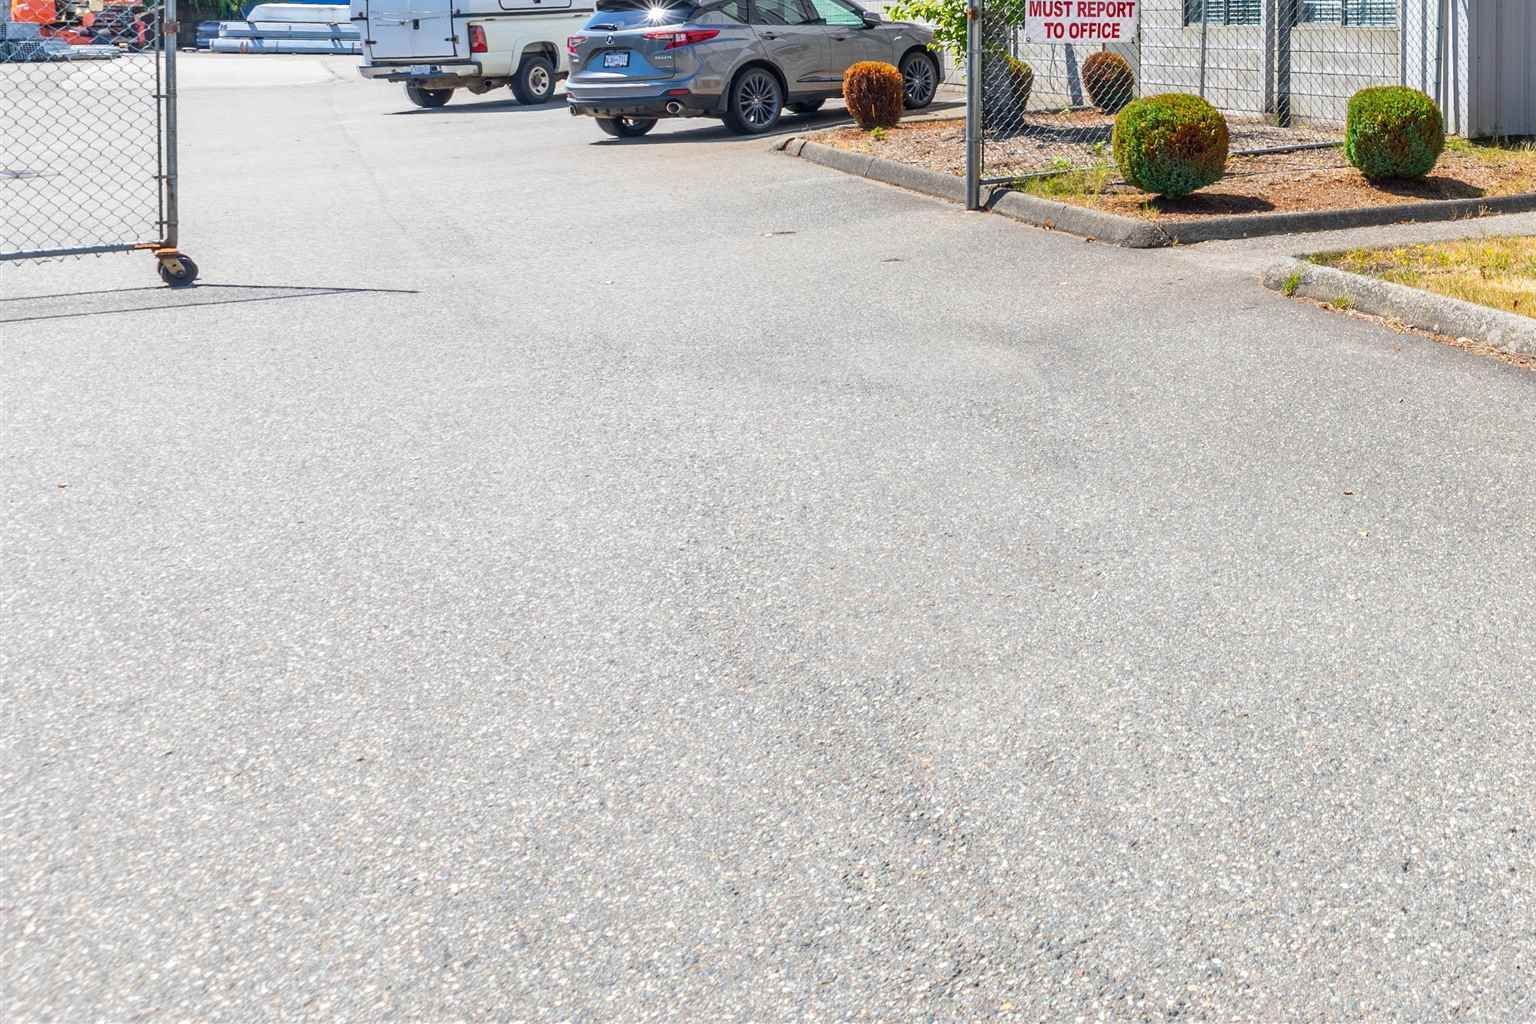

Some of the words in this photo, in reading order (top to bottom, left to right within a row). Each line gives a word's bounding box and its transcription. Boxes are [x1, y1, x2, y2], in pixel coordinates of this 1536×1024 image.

[1029, 0, 1073, 17] MUST
[1076, 1, 1136, 18] REPORT
[1043, 22, 1065, 39] TO
[1068, 22, 1121, 39] OFFICE
